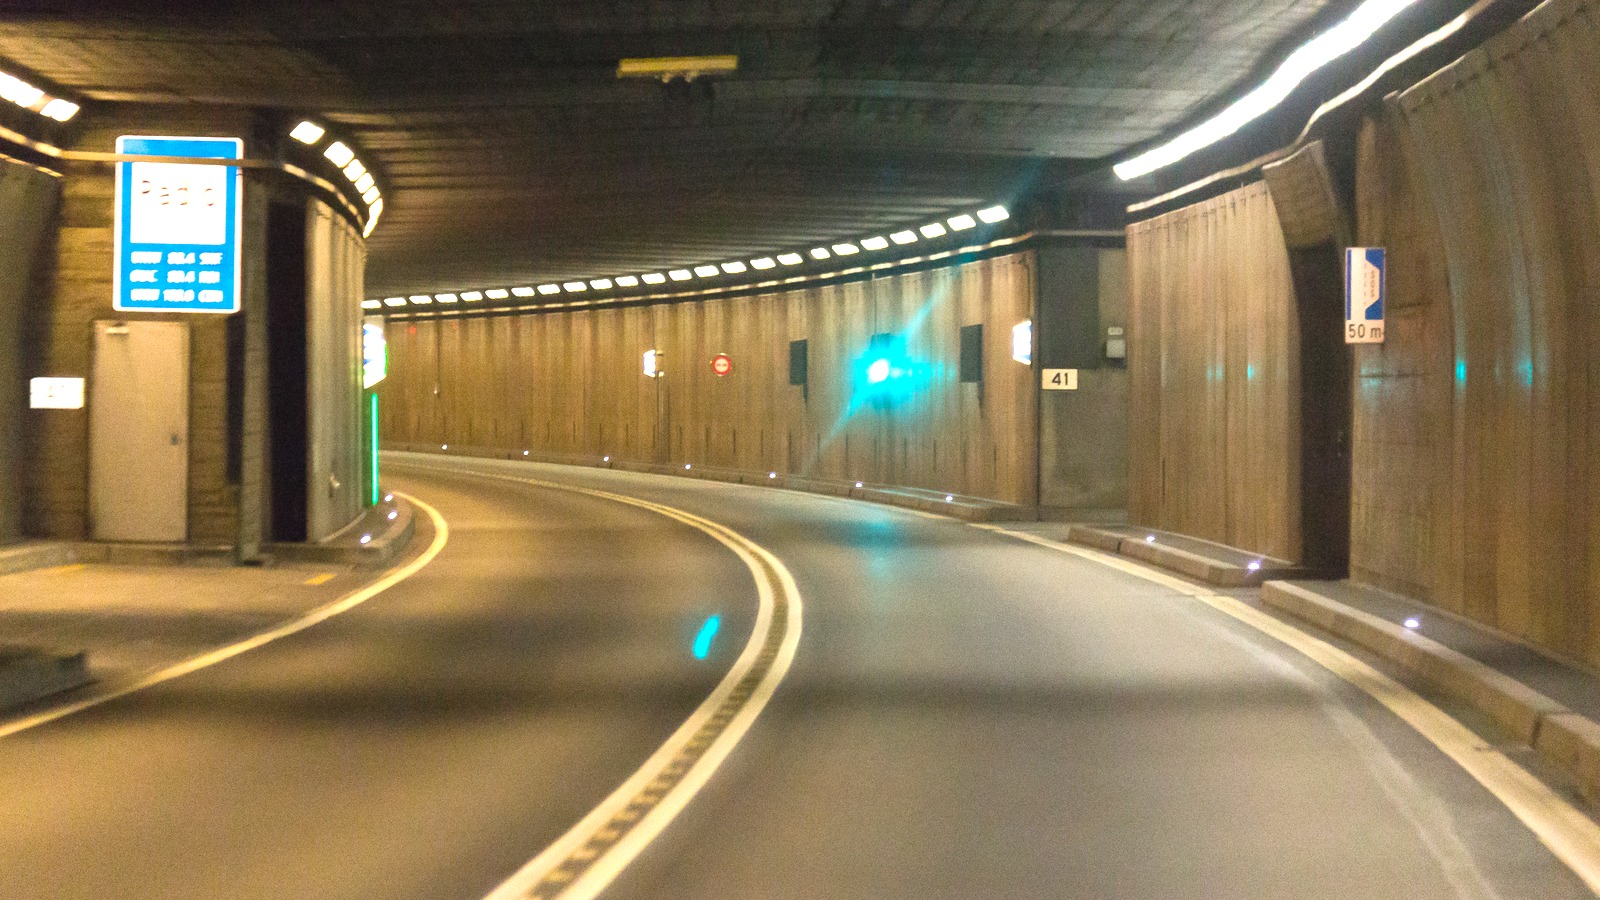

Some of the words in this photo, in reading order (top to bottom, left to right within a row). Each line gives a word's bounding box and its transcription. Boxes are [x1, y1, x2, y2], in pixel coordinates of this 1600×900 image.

[1348, 323, 1366, 339] 50
[1370, 326, 1382, 339] m
[1051, 372, 1069, 386] 41
